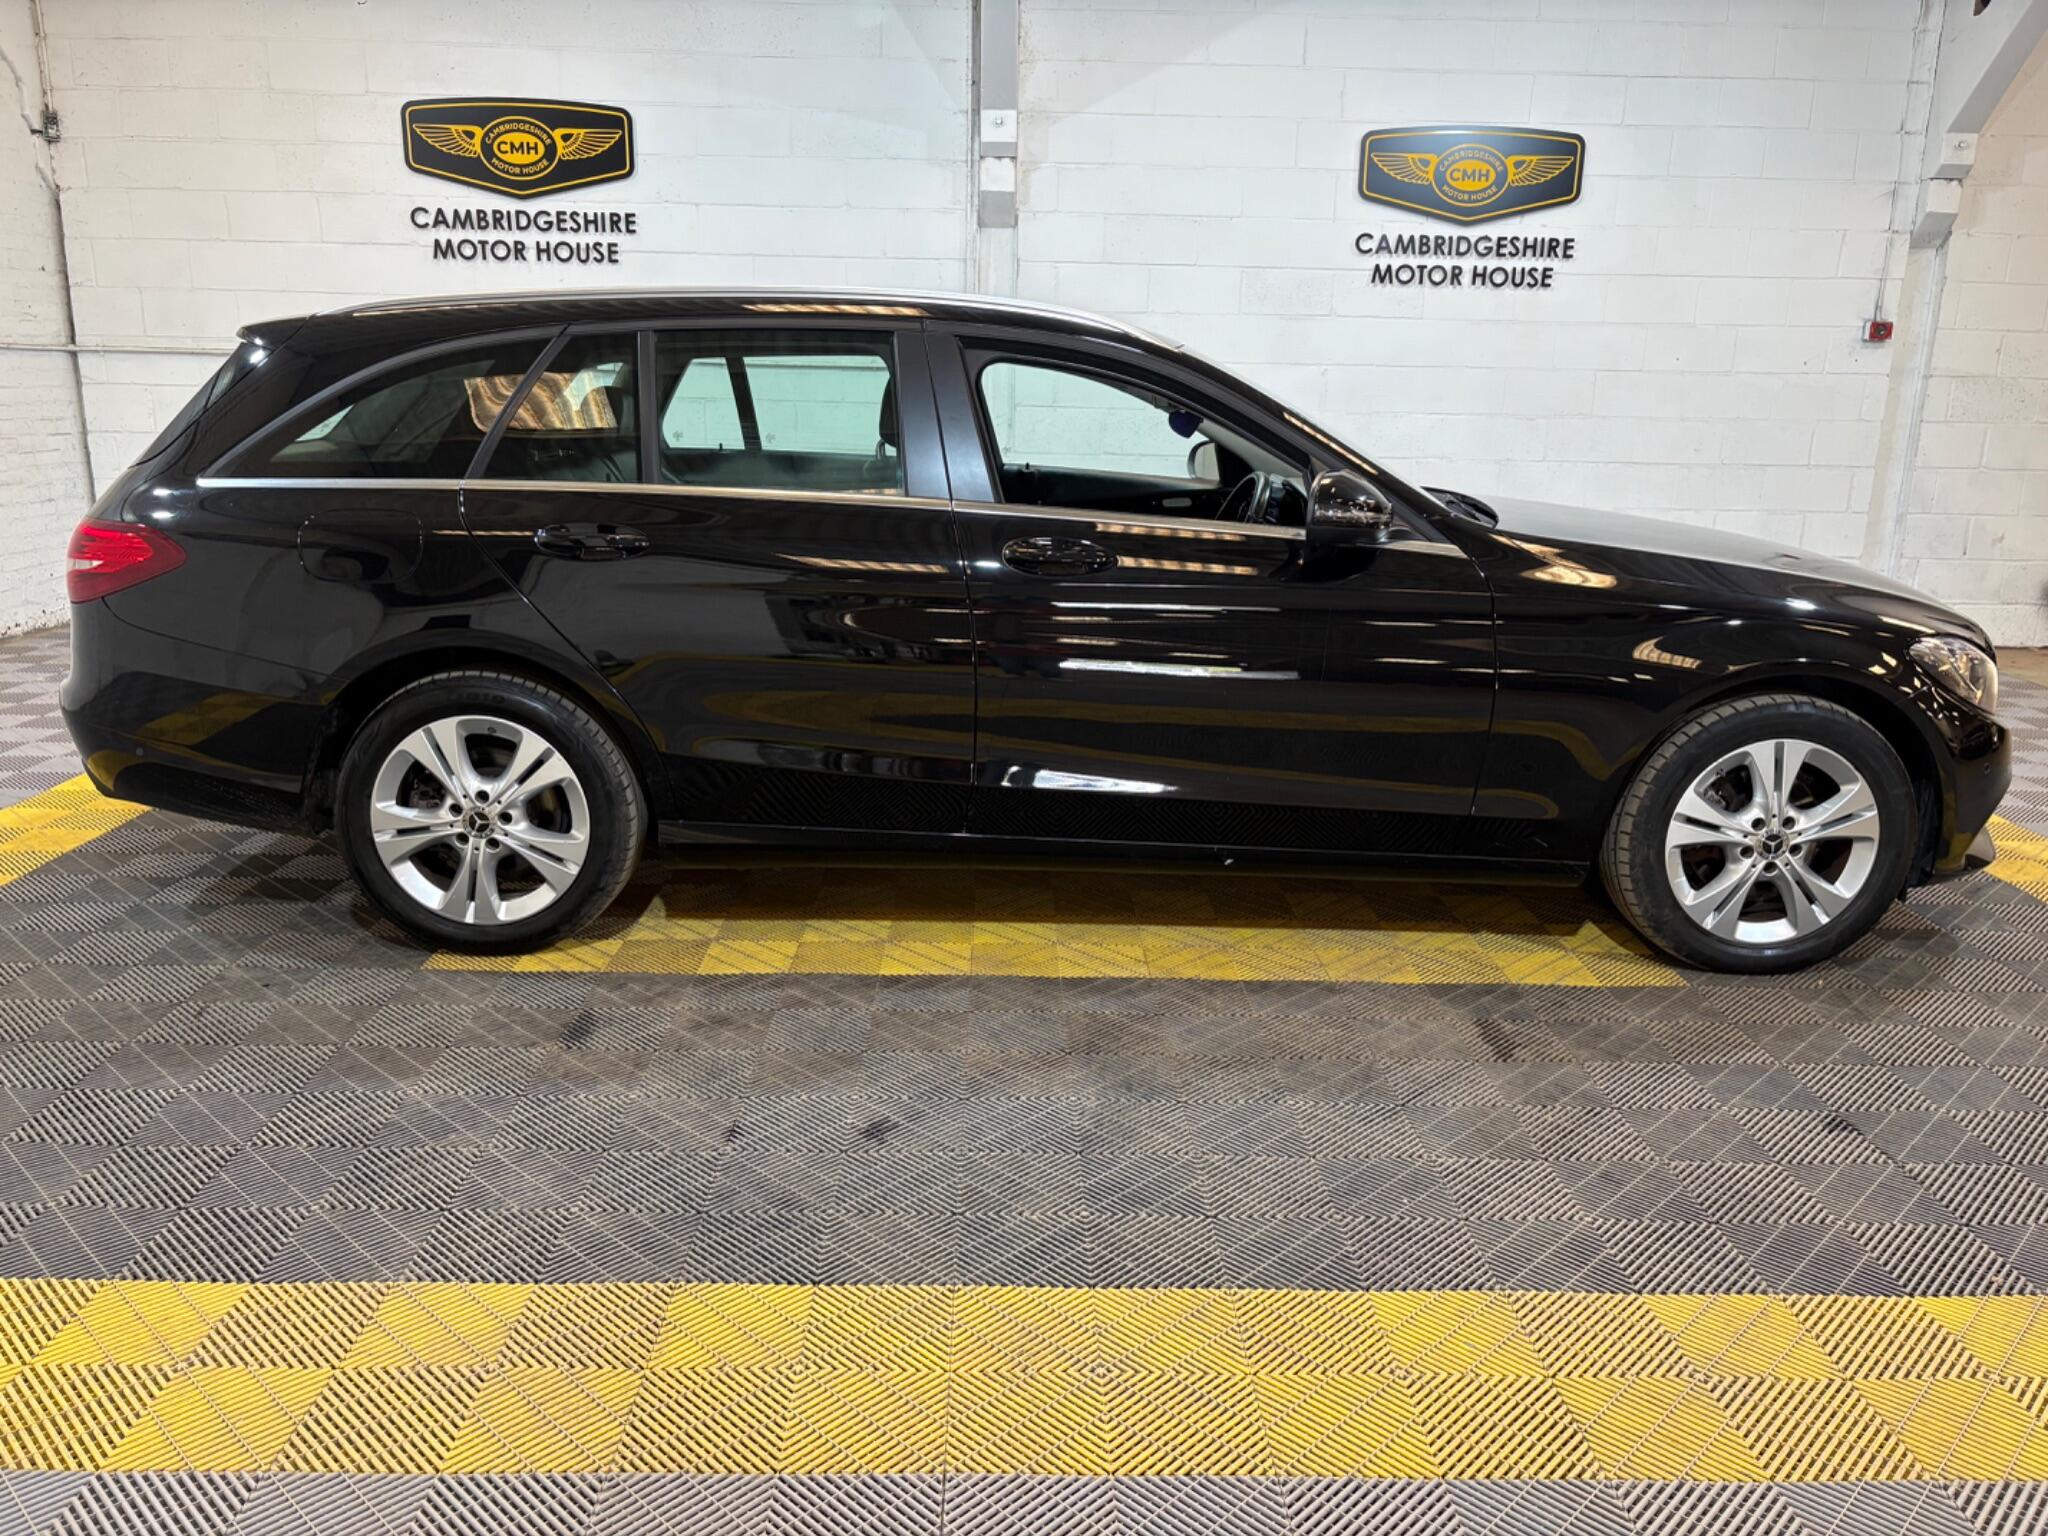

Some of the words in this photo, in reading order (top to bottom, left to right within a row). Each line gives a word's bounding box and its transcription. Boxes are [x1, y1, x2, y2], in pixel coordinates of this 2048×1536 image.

[485, 122, 553, 146] CAMBRIDGESHIRE
[497, 141, 539, 155] CMH
[491, 157, 521, 174] MOTOR
[522, 158, 550, 174] HOUSE
[1450, 168, 1491, 183] CMH
[1442, 184, 1469, 201] MOTOR
[1470, 185, 1498, 201] HOUSE
[410, 207, 637, 234] CAMBRIDGESHIRE
[433, 239, 527, 262] MOTOR
[536, 240, 620, 264] HOUSE
[1355, 233, 1576, 259] CAMBRIDGESHIRE
[1371, 264, 1463, 286] MOTOR
[1471, 265, 1555, 288] HOUSE
